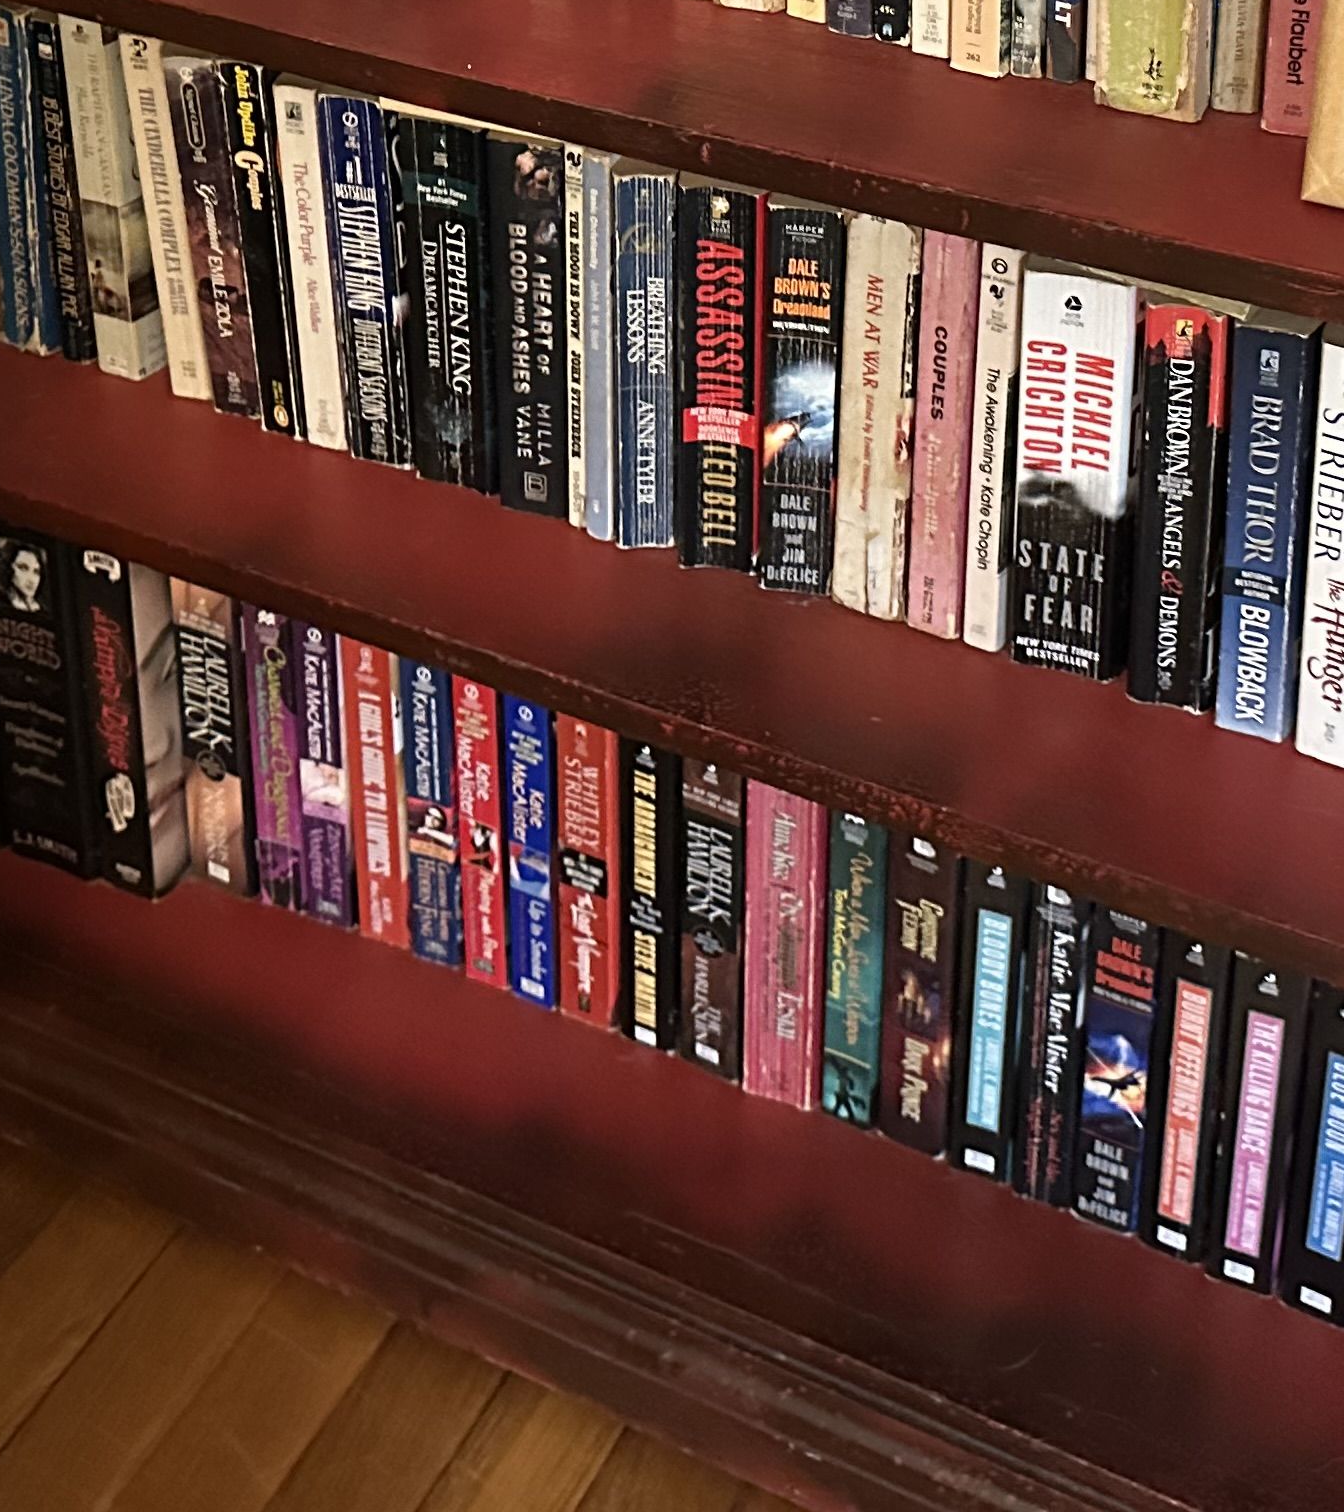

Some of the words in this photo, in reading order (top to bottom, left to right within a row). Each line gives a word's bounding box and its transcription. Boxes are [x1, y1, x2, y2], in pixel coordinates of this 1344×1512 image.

[1287, 5, 1309, 85] Flaubert
[444, 221, 471, 328] STEPHEN
[508, 224, 527, 291] BLOOD
[774, 278, 830, 299] BROWN'S
[788, 258, 819, 277] DALE
[422, 241, 440, 368] DREAMCATCHER
[531, 269, 553, 350] HEART
[695, 239, 746, 409] ASSASSIN
[448, 333, 472, 394] KING
[511, 320, 531, 395] ASHES
[930, 326, 949, 421] COUPLES
[516, 407, 532, 459] VANE
[536, 402, 553, 466] MILLA
[979, 399, 999, 475] Awakening
[1023, 340, 1067, 473] CRICHTON
[1071, 353, 1115, 473] MICHAEL
[1248, 395, 1283, 477] BRAD
[980, 487, 994, 522] Kate
[1161, 498, 1184, 570] ANGELS
[1242, 485, 1277, 564] THOR
[976, 523, 991, 570] Chopin
[1019, 540, 1105, 583] STATE
[1025, 599, 1094, 635] FEAR
[1049, 576, 1073, 595] OF
[1158, 596, 1179, 668] DEMONS
[1235, 604, 1270, 723] BLOWBACK
[562, 757, 584, 847] STRIEBER
[584, 767, 601, 851] WHITLEY
[1052, 931, 1076, 988] Katie
[1044, 992, 1070, 1095] MacAlister
